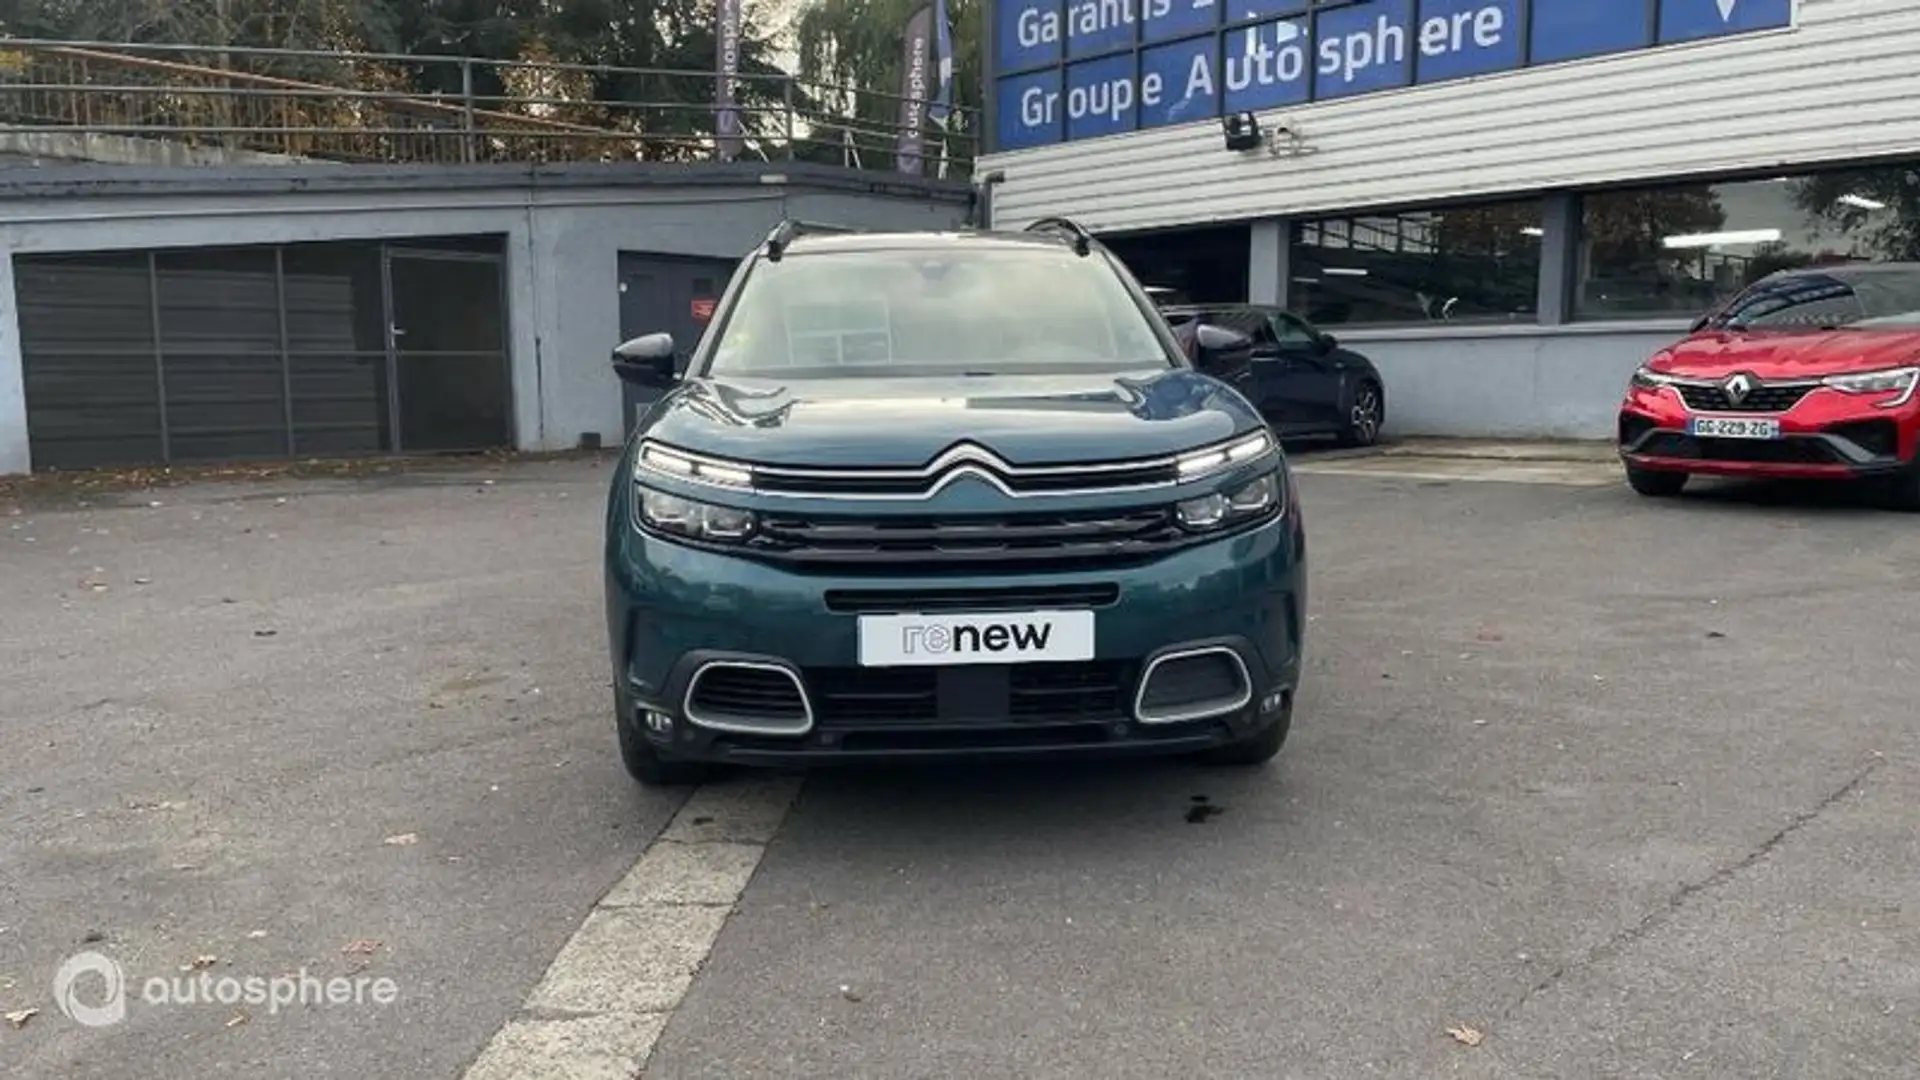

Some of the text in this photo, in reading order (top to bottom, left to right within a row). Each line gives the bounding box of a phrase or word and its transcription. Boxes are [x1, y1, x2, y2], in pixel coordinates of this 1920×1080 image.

[1021, 7, 1503, 126] Groupe Autosphere
[902, 623, 1051, 654] renew
